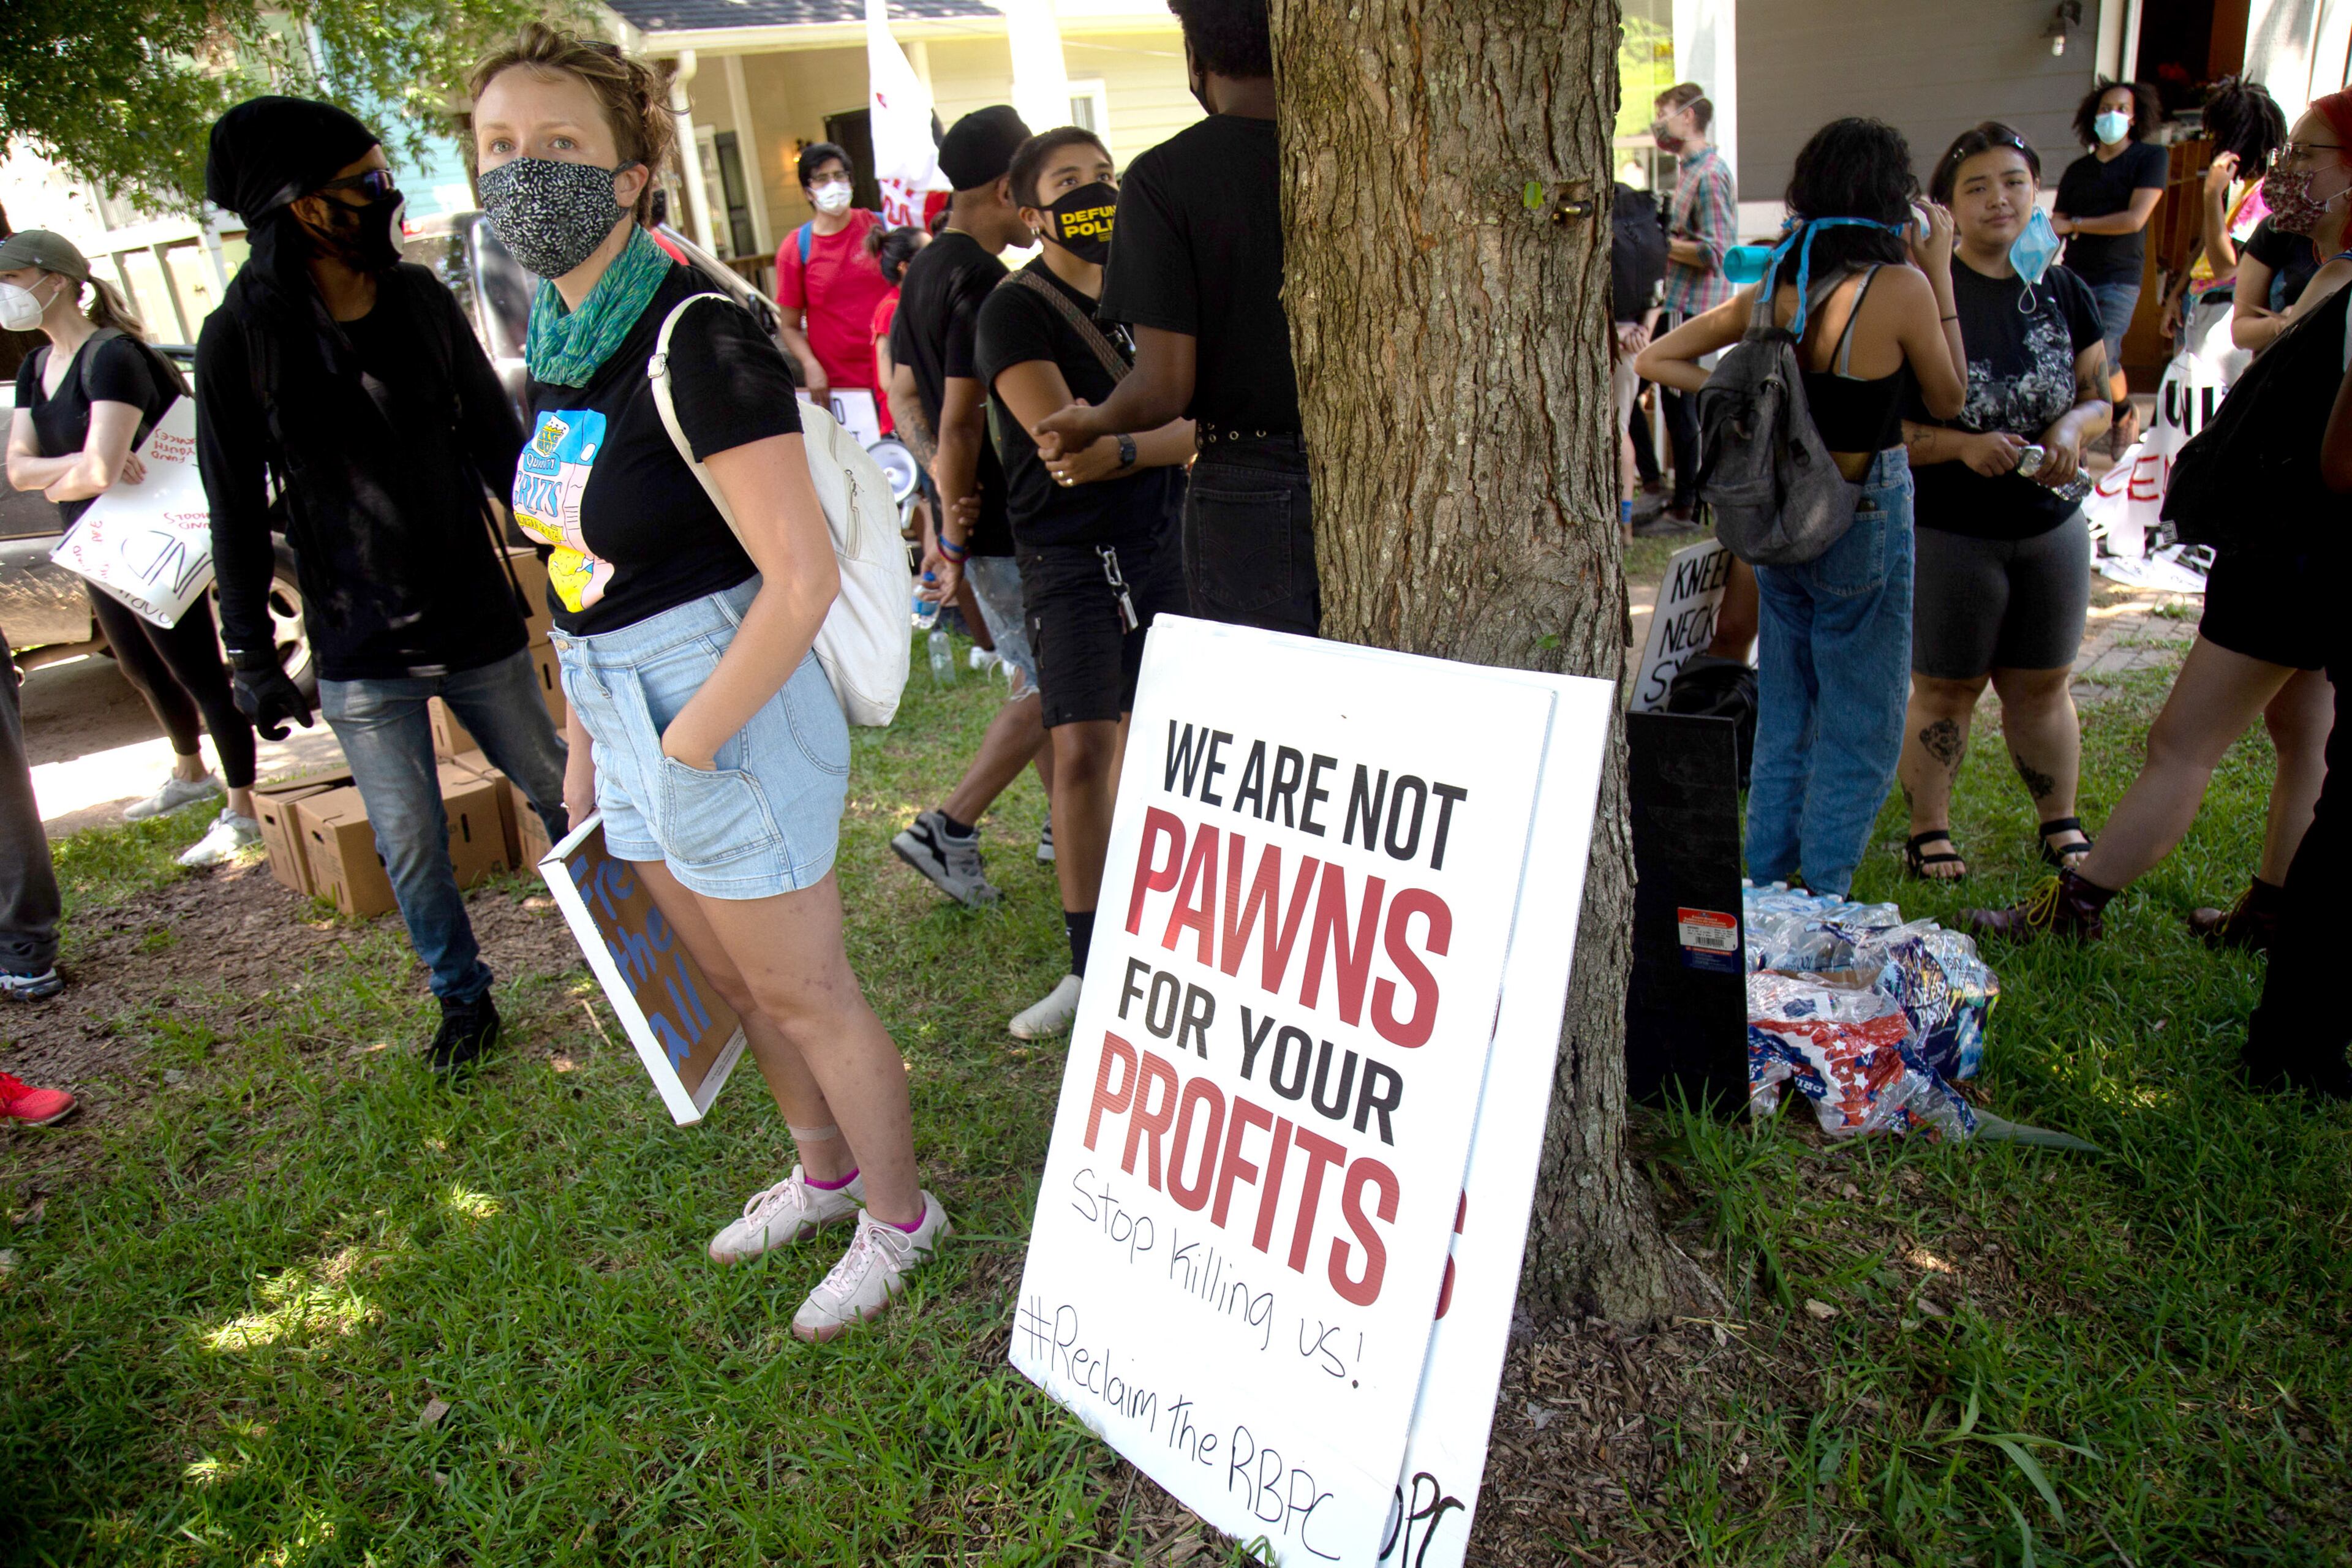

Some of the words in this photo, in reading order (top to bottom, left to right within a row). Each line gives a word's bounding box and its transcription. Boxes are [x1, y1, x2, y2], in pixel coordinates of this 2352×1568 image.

[1060, 205, 1117, 225] DEFUN
[1063, 219, 1114, 238] POLI
[151, 451, 185, 463] FUND
[154, 440, 195, 455] YOUTH
[1164, 719, 1234, 807] WE
[1232, 739, 1338, 837] ARE
[1343, 763, 1468, 871] NOT
[570, 854, 637, 935] Fre
[1125, 805, 1453, 1049] PAWNS
[1118, 956, 1216, 1060] FOR
[1240, 1005, 1403, 1147] YOUR
[1071, 1168, 1154, 1264] Stop
[1084, 1030, 1400, 1307] PROFITS
[1019, 1295, 1157, 1433] #Reclaim
[1229, 1425, 1341, 1561] RBPC
